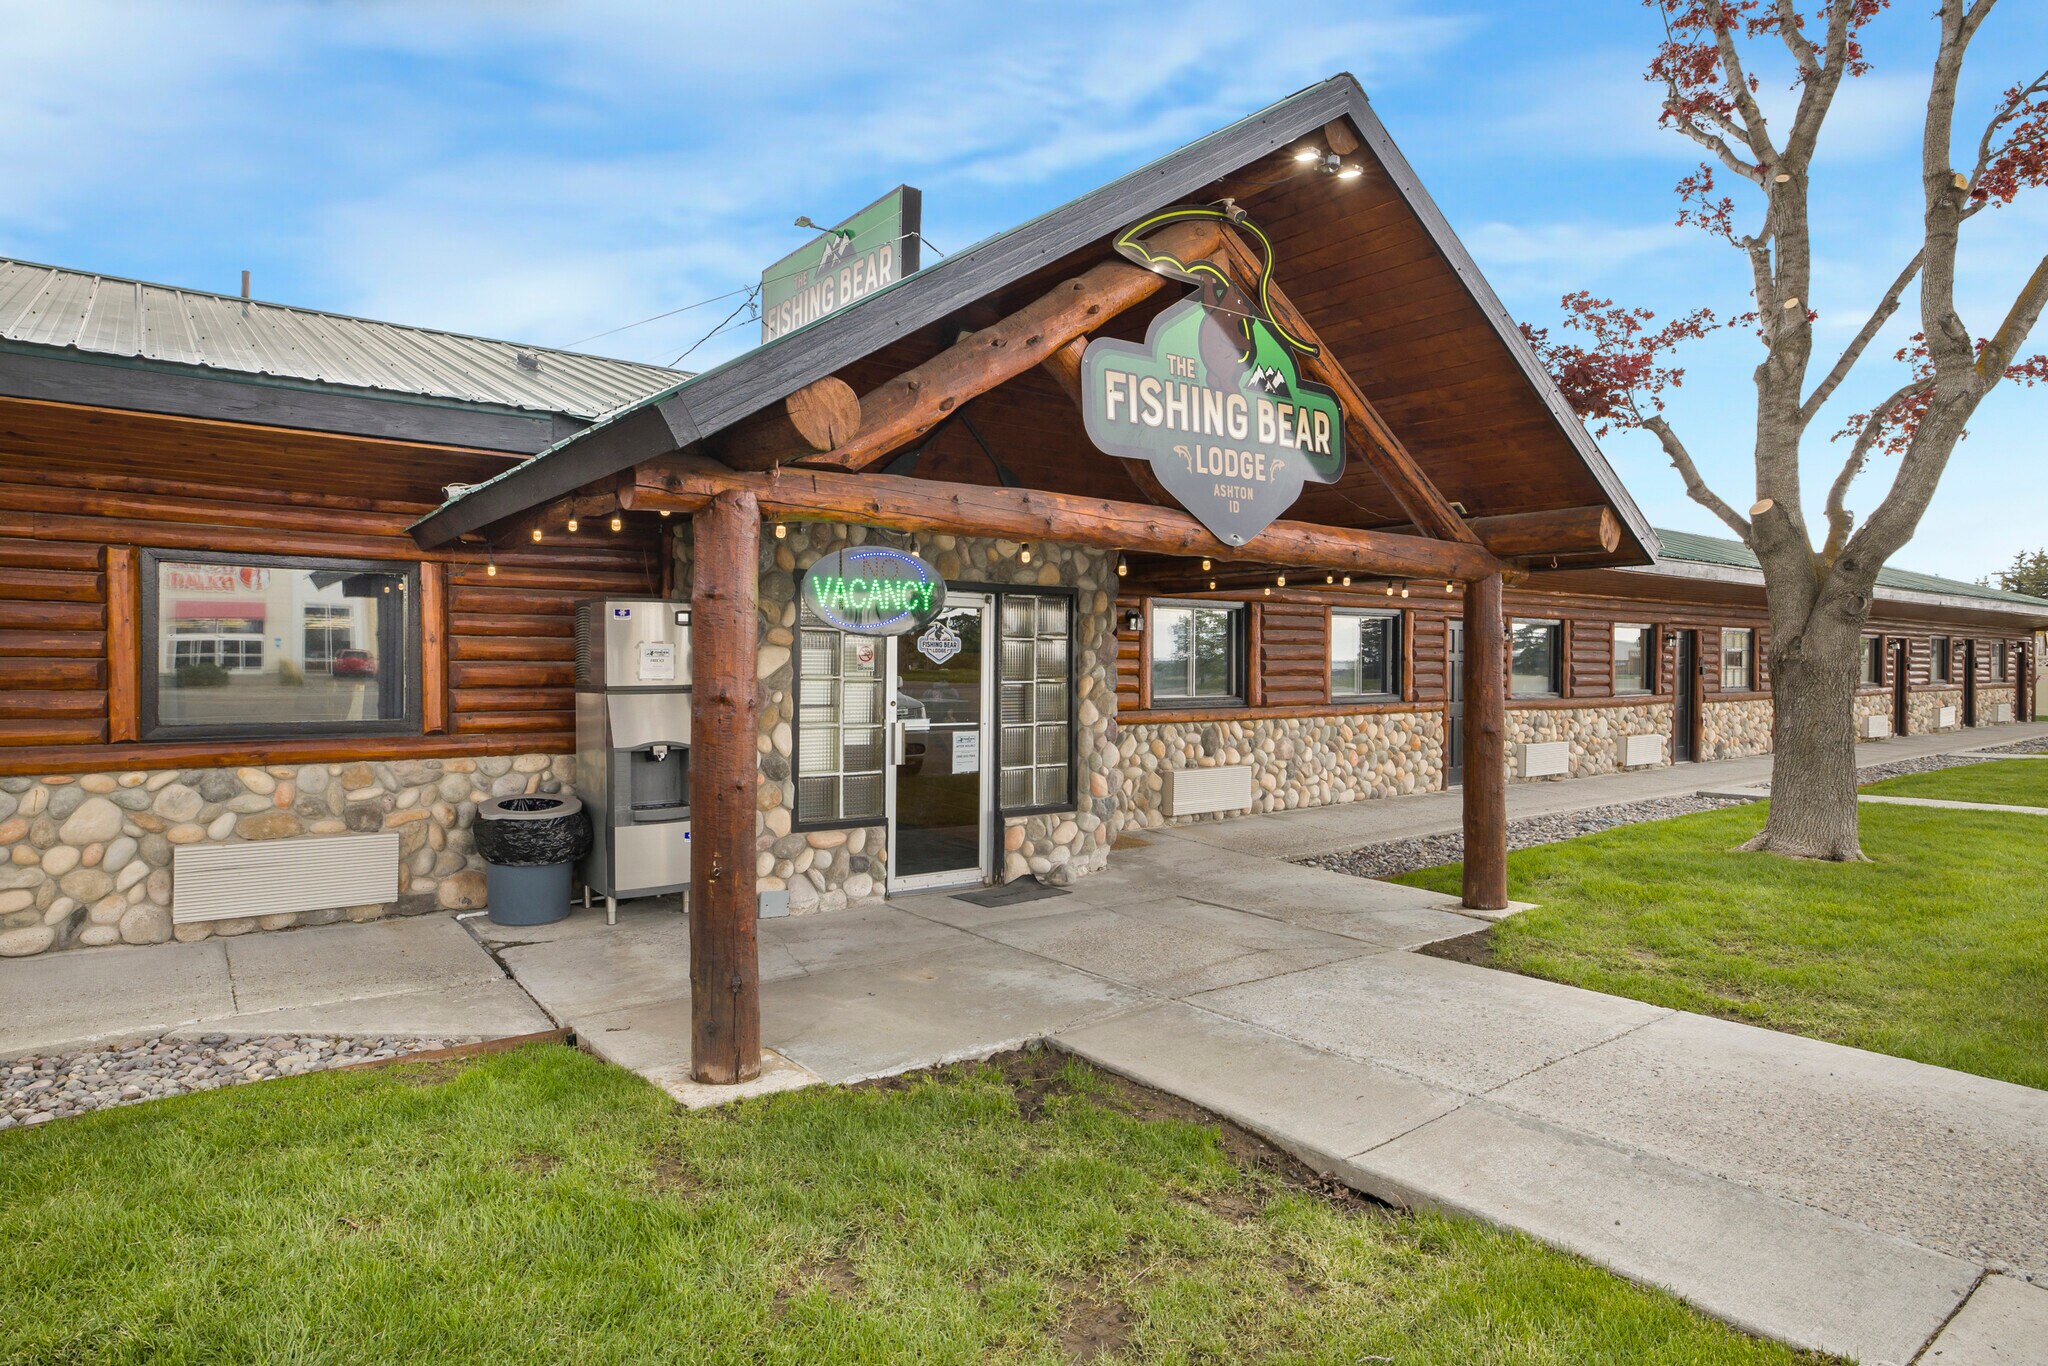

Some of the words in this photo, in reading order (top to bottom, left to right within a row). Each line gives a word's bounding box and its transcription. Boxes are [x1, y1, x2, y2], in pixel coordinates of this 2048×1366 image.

[767, 276, 835, 341] FISHING
[840, 245, 893, 306] BEAR
[793, 272, 808, 291] THE
[1166, 354, 1196, 378] THE
[1104, 369, 1248, 441] FISHING
[1257, 397, 1331, 455] BEAR
[1196, 444, 1266, 481] LODGE
[1214, 484, 1254, 500] ASHTON
[1229, 500, 1240, 513] ID
[862, 557, 899, 580] NO
[813, 576, 935, 611] VACANCY
